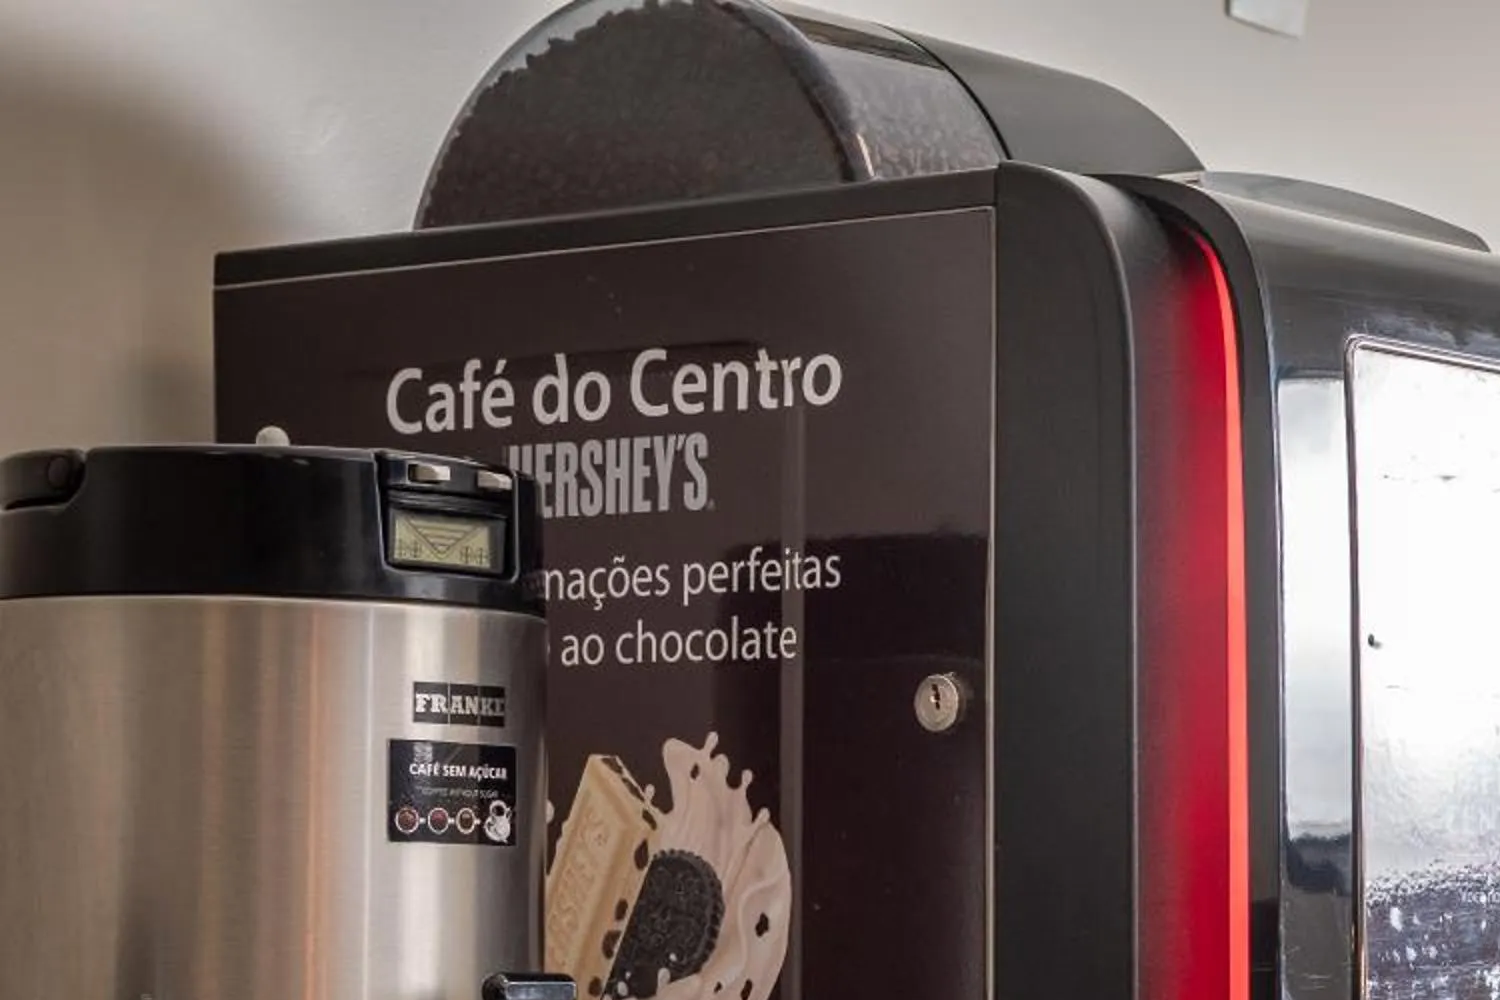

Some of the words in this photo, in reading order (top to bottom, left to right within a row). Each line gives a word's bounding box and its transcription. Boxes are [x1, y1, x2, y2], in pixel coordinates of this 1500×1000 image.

[386, 358, 515, 435] Café
[532, 352, 611, 425] do
[629, 347, 843, 418] Centro
[544, 555, 671, 611] nações
[682, 546, 842, 607] perfeitas
[560, 633, 605, 667] ao
[615, 615, 798, 664] chocolate
[415, 693, 505, 716] FRANKE
[409, 761, 440, 777] CAFÉ
[443, 764, 467, 777] SEM
[468, 763, 508, 783] AÇÚCAR
